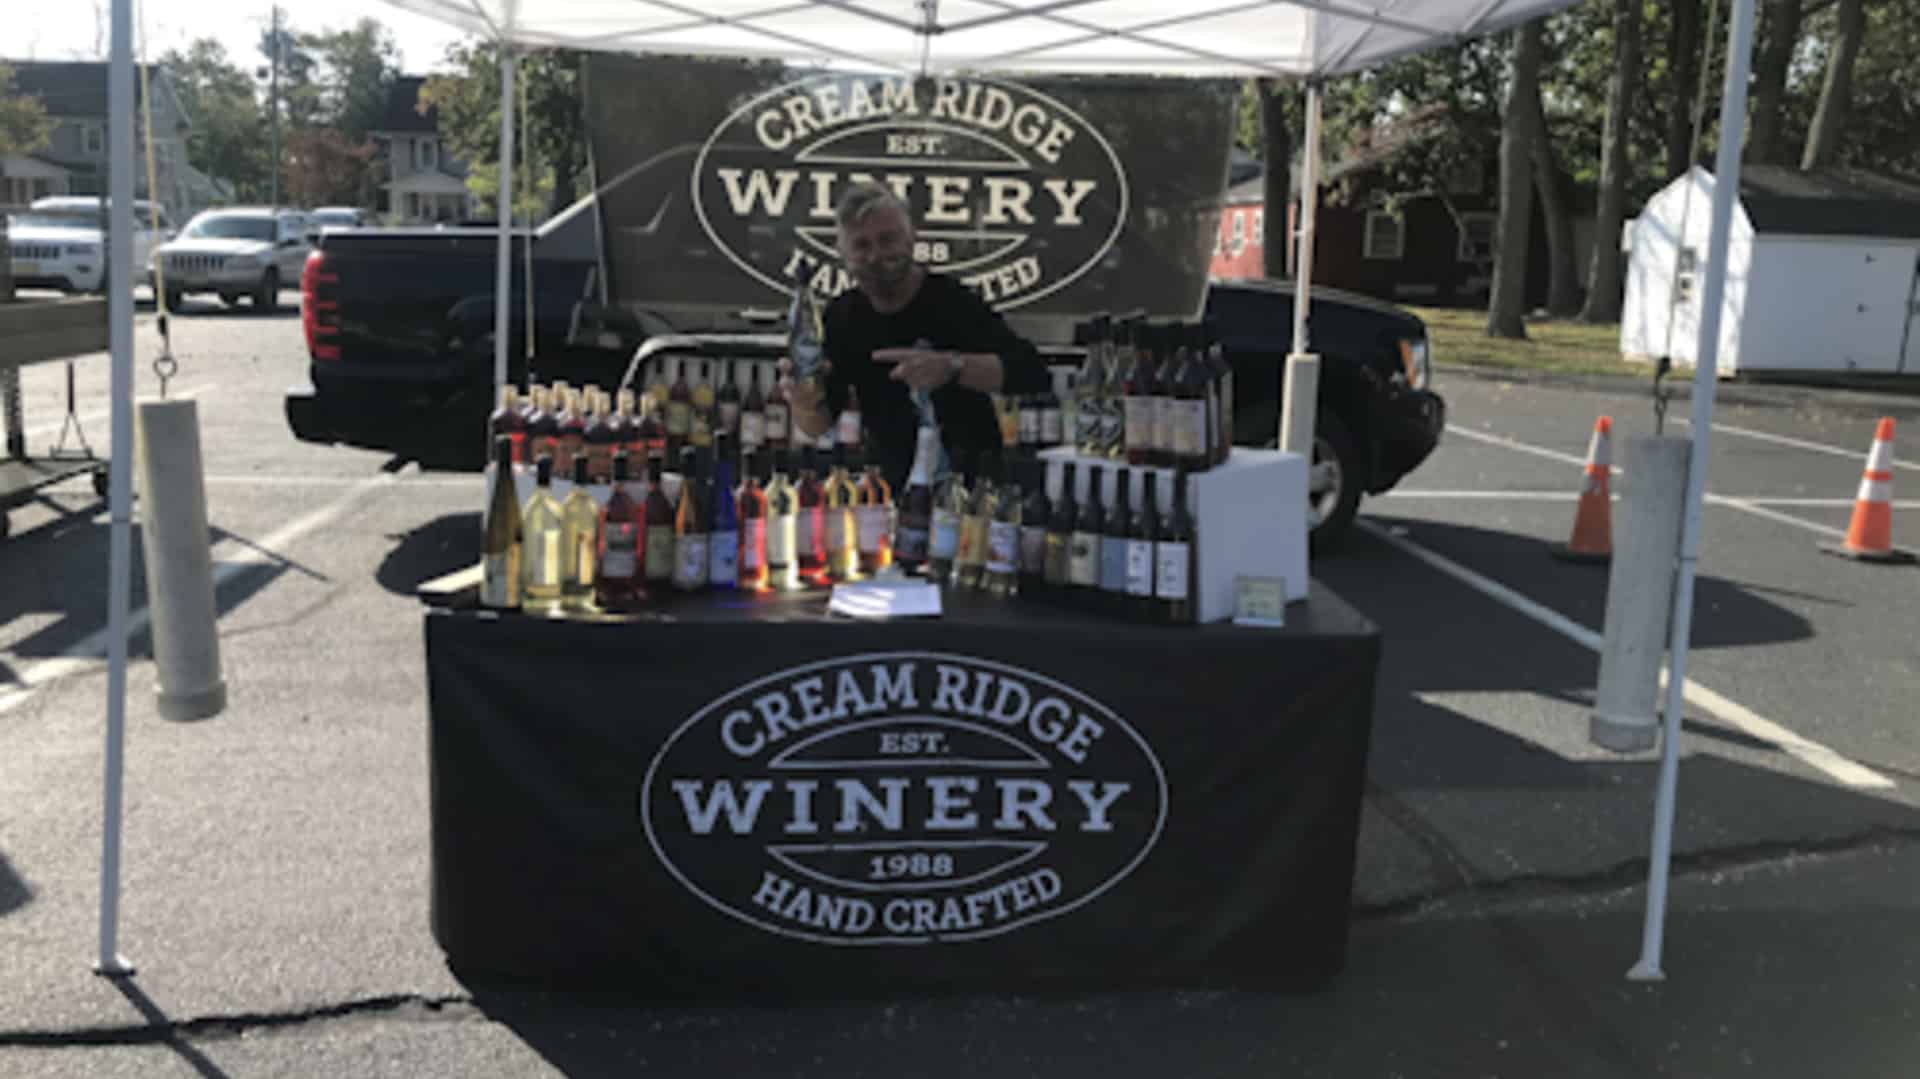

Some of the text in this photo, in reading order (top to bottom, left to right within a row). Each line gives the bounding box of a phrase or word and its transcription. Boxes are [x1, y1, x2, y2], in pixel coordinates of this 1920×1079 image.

[755, 79, 1075, 164] CREAM RIDGE
[886, 134, 948, 155] EST.
[912, 241, 950, 262] 88
[721, 663, 1104, 764] CREAM RIDGE
[879, 732, 951, 754] EST.
[672, 777, 1131, 834] WINERY
[869, 853, 954, 879] 1988
[752, 867, 1062, 934] HAND CRAFTED
